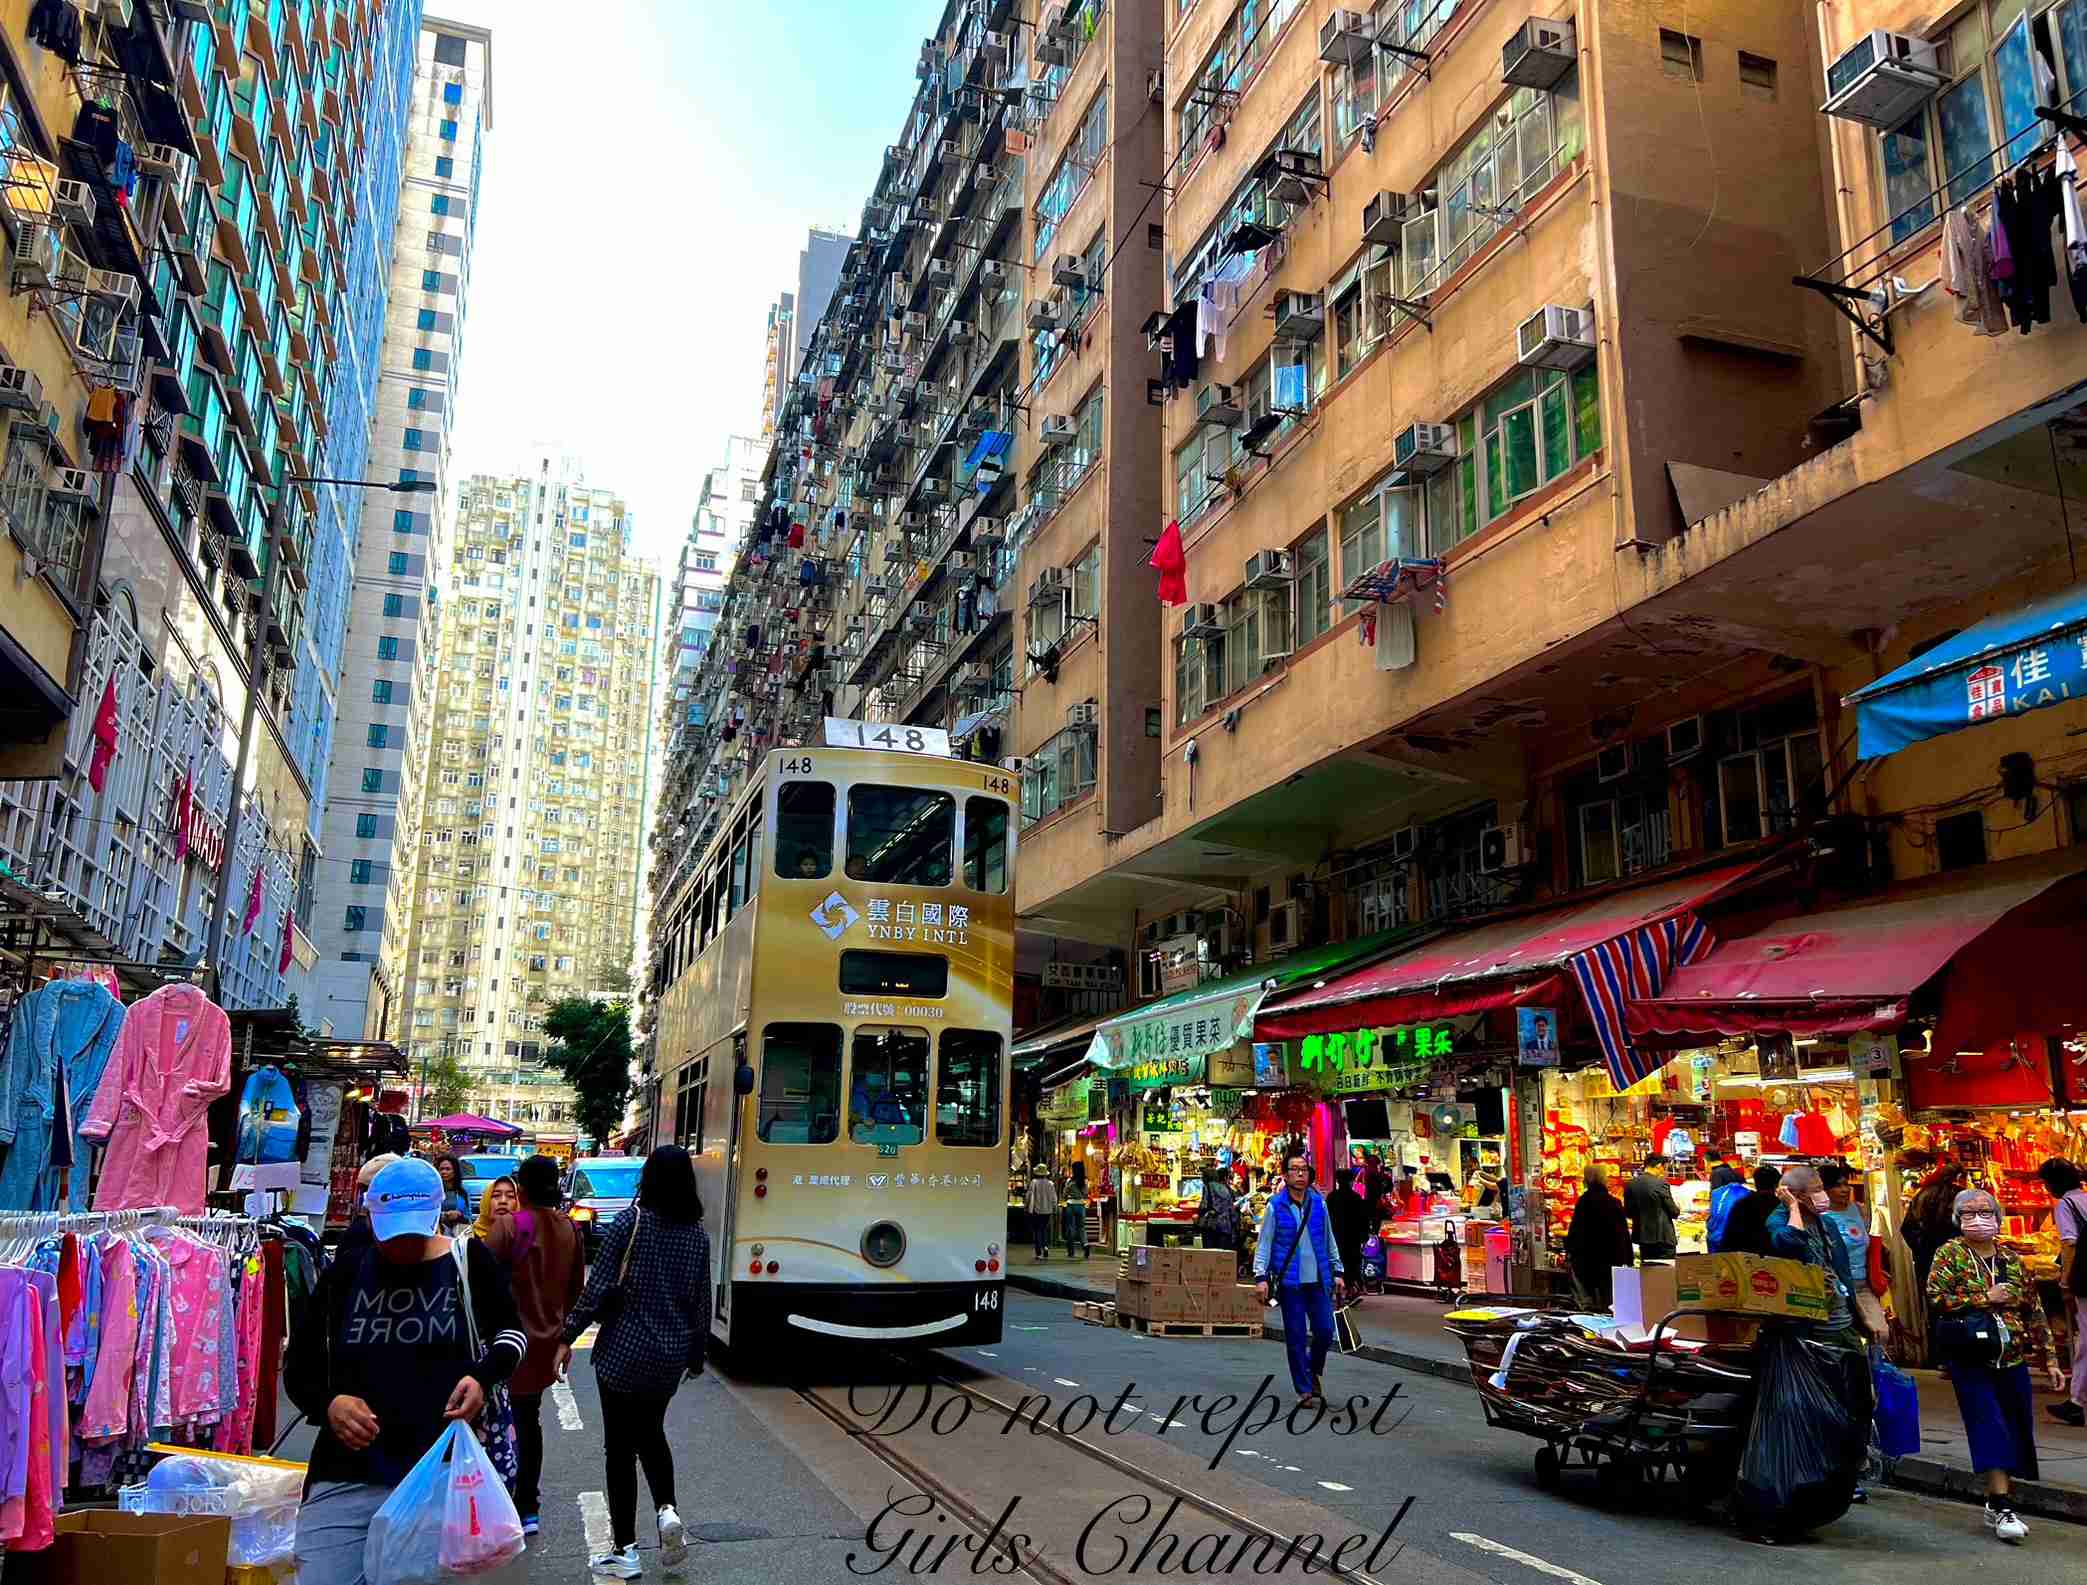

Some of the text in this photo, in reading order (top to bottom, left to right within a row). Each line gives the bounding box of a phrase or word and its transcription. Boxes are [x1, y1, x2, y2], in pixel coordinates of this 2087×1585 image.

[2012, 681, 2069, 711] KAI
[857, 725, 927, 752] 148
[778, 757, 812, 776] 148
[982, 775, 1009, 795] 148
[866, 897, 970, 929] 雲白國際
[867, 924, 969, 945] YNBY INTL
[904, 1004, 945, 1018] 00030
[353, 1287, 456, 1314] MOVE
[974, 1290, 999, 1311] 148
